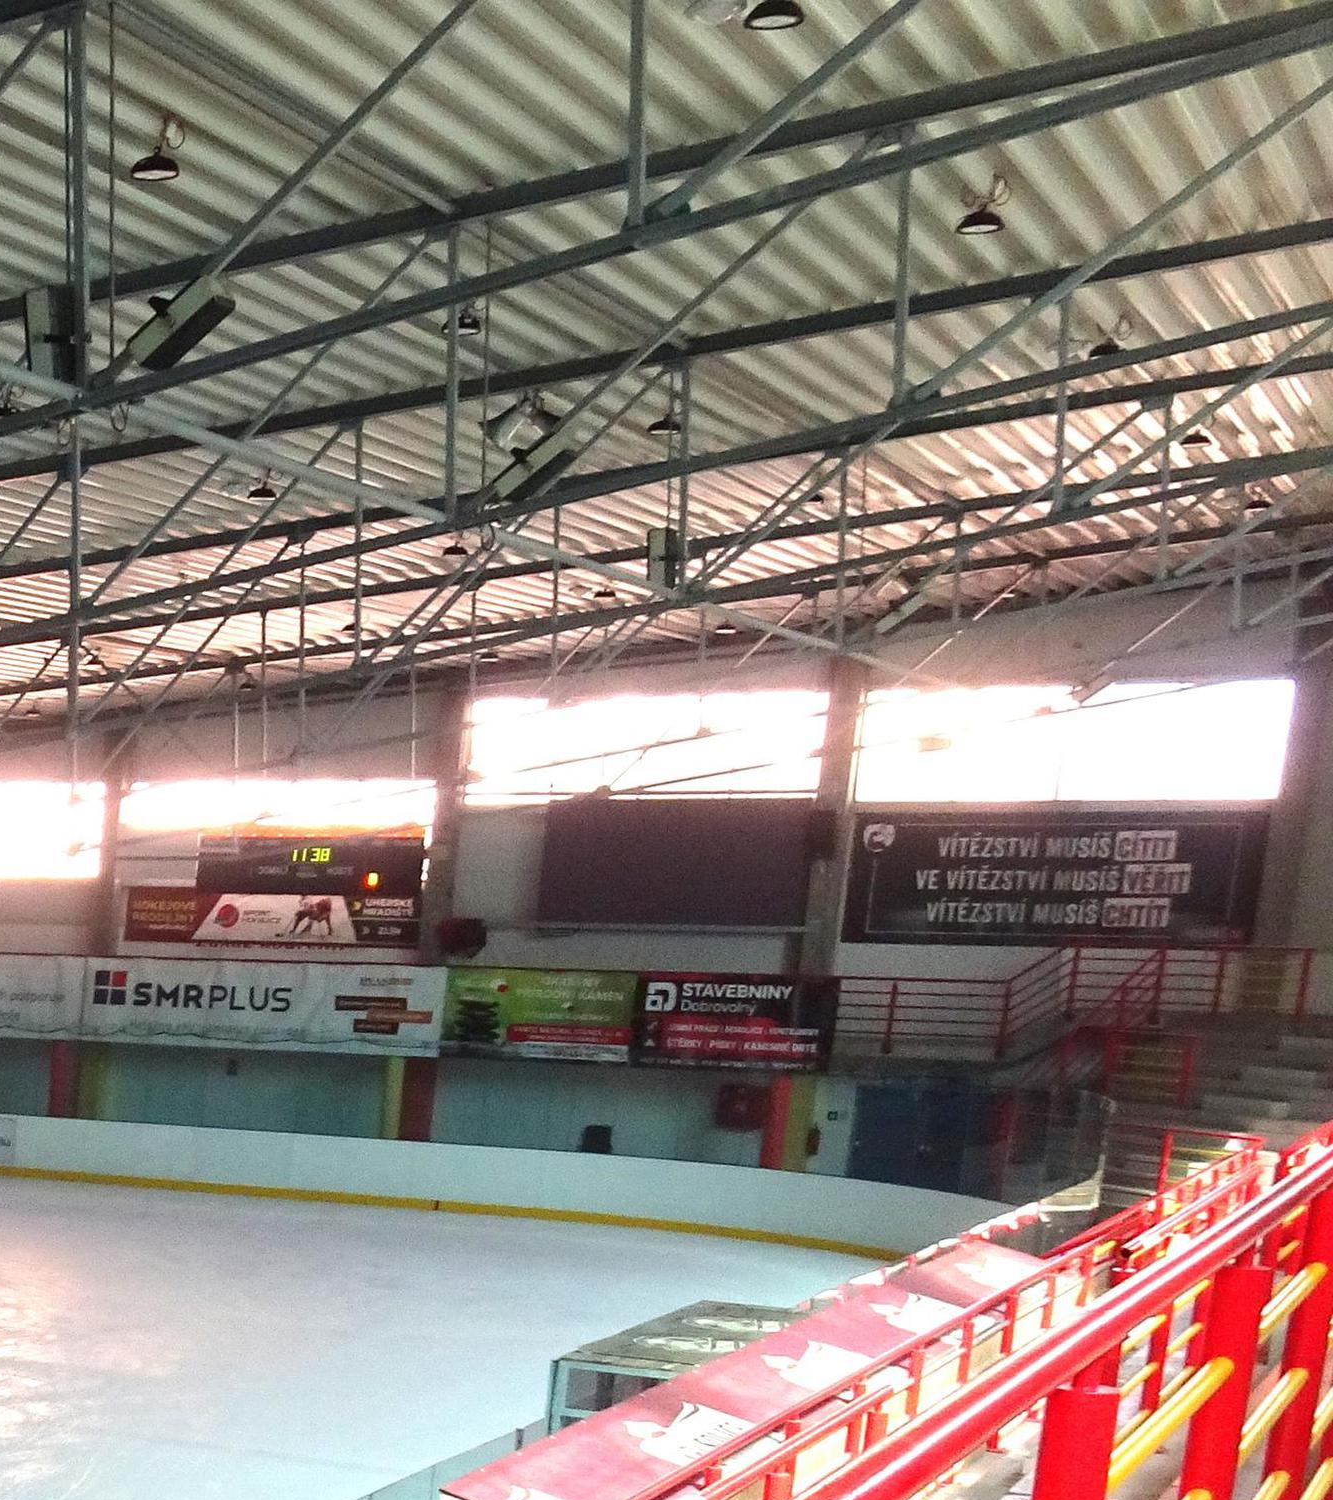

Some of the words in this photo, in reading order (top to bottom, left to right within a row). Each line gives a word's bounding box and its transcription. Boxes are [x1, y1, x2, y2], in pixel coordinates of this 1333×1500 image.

[916, 869, 939, 890] VE
[133, 982, 293, 1013] SMRPLUS
[682, 982, 793, 1000] STAVEBNINY
